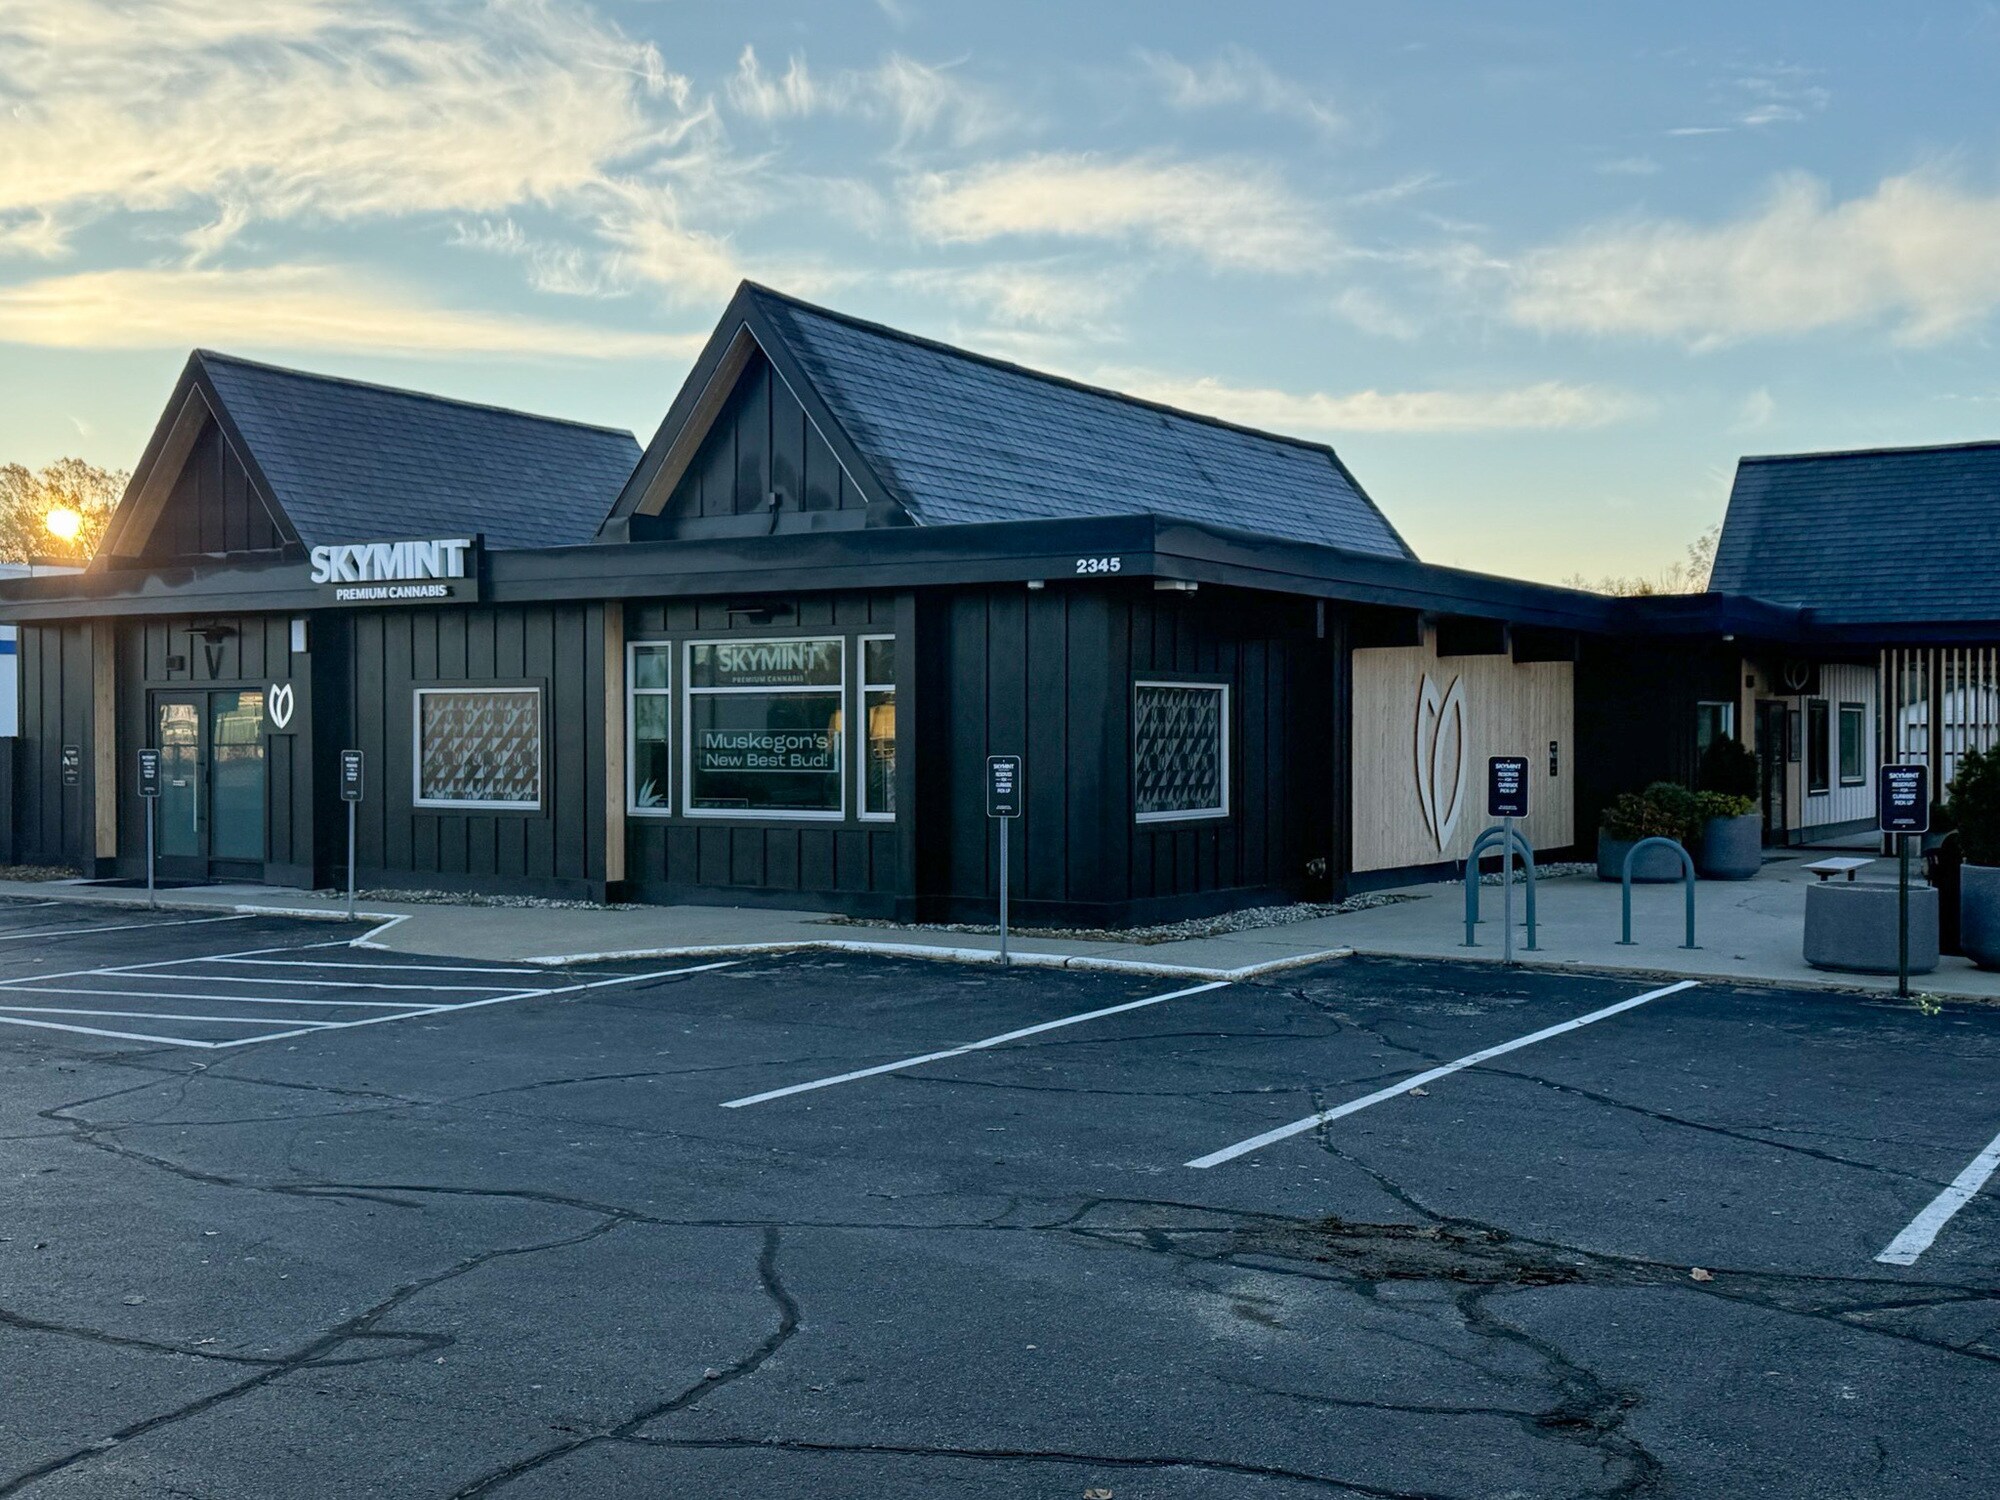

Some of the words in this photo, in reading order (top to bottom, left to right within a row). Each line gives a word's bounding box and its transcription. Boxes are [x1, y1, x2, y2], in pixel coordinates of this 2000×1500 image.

[310, 539, 470, 583] SKYMINT
[1076, 557, 1121, 573] 2345
[336, 587, 387, 601] PREMIUM
[388, 584, 448, 598] CANNABIS
[718, 644, 819, 672] SKYMINT
[732, 676, 766, 684] PREMIUM
[767, 674, 804, 683] CANNABIS
[705, 732, 829, 753] Muskegon's
[705, 753, 743, 767] New
[747, 753, 786, 767] Best
[790, 752, 829, 767] Bud!
